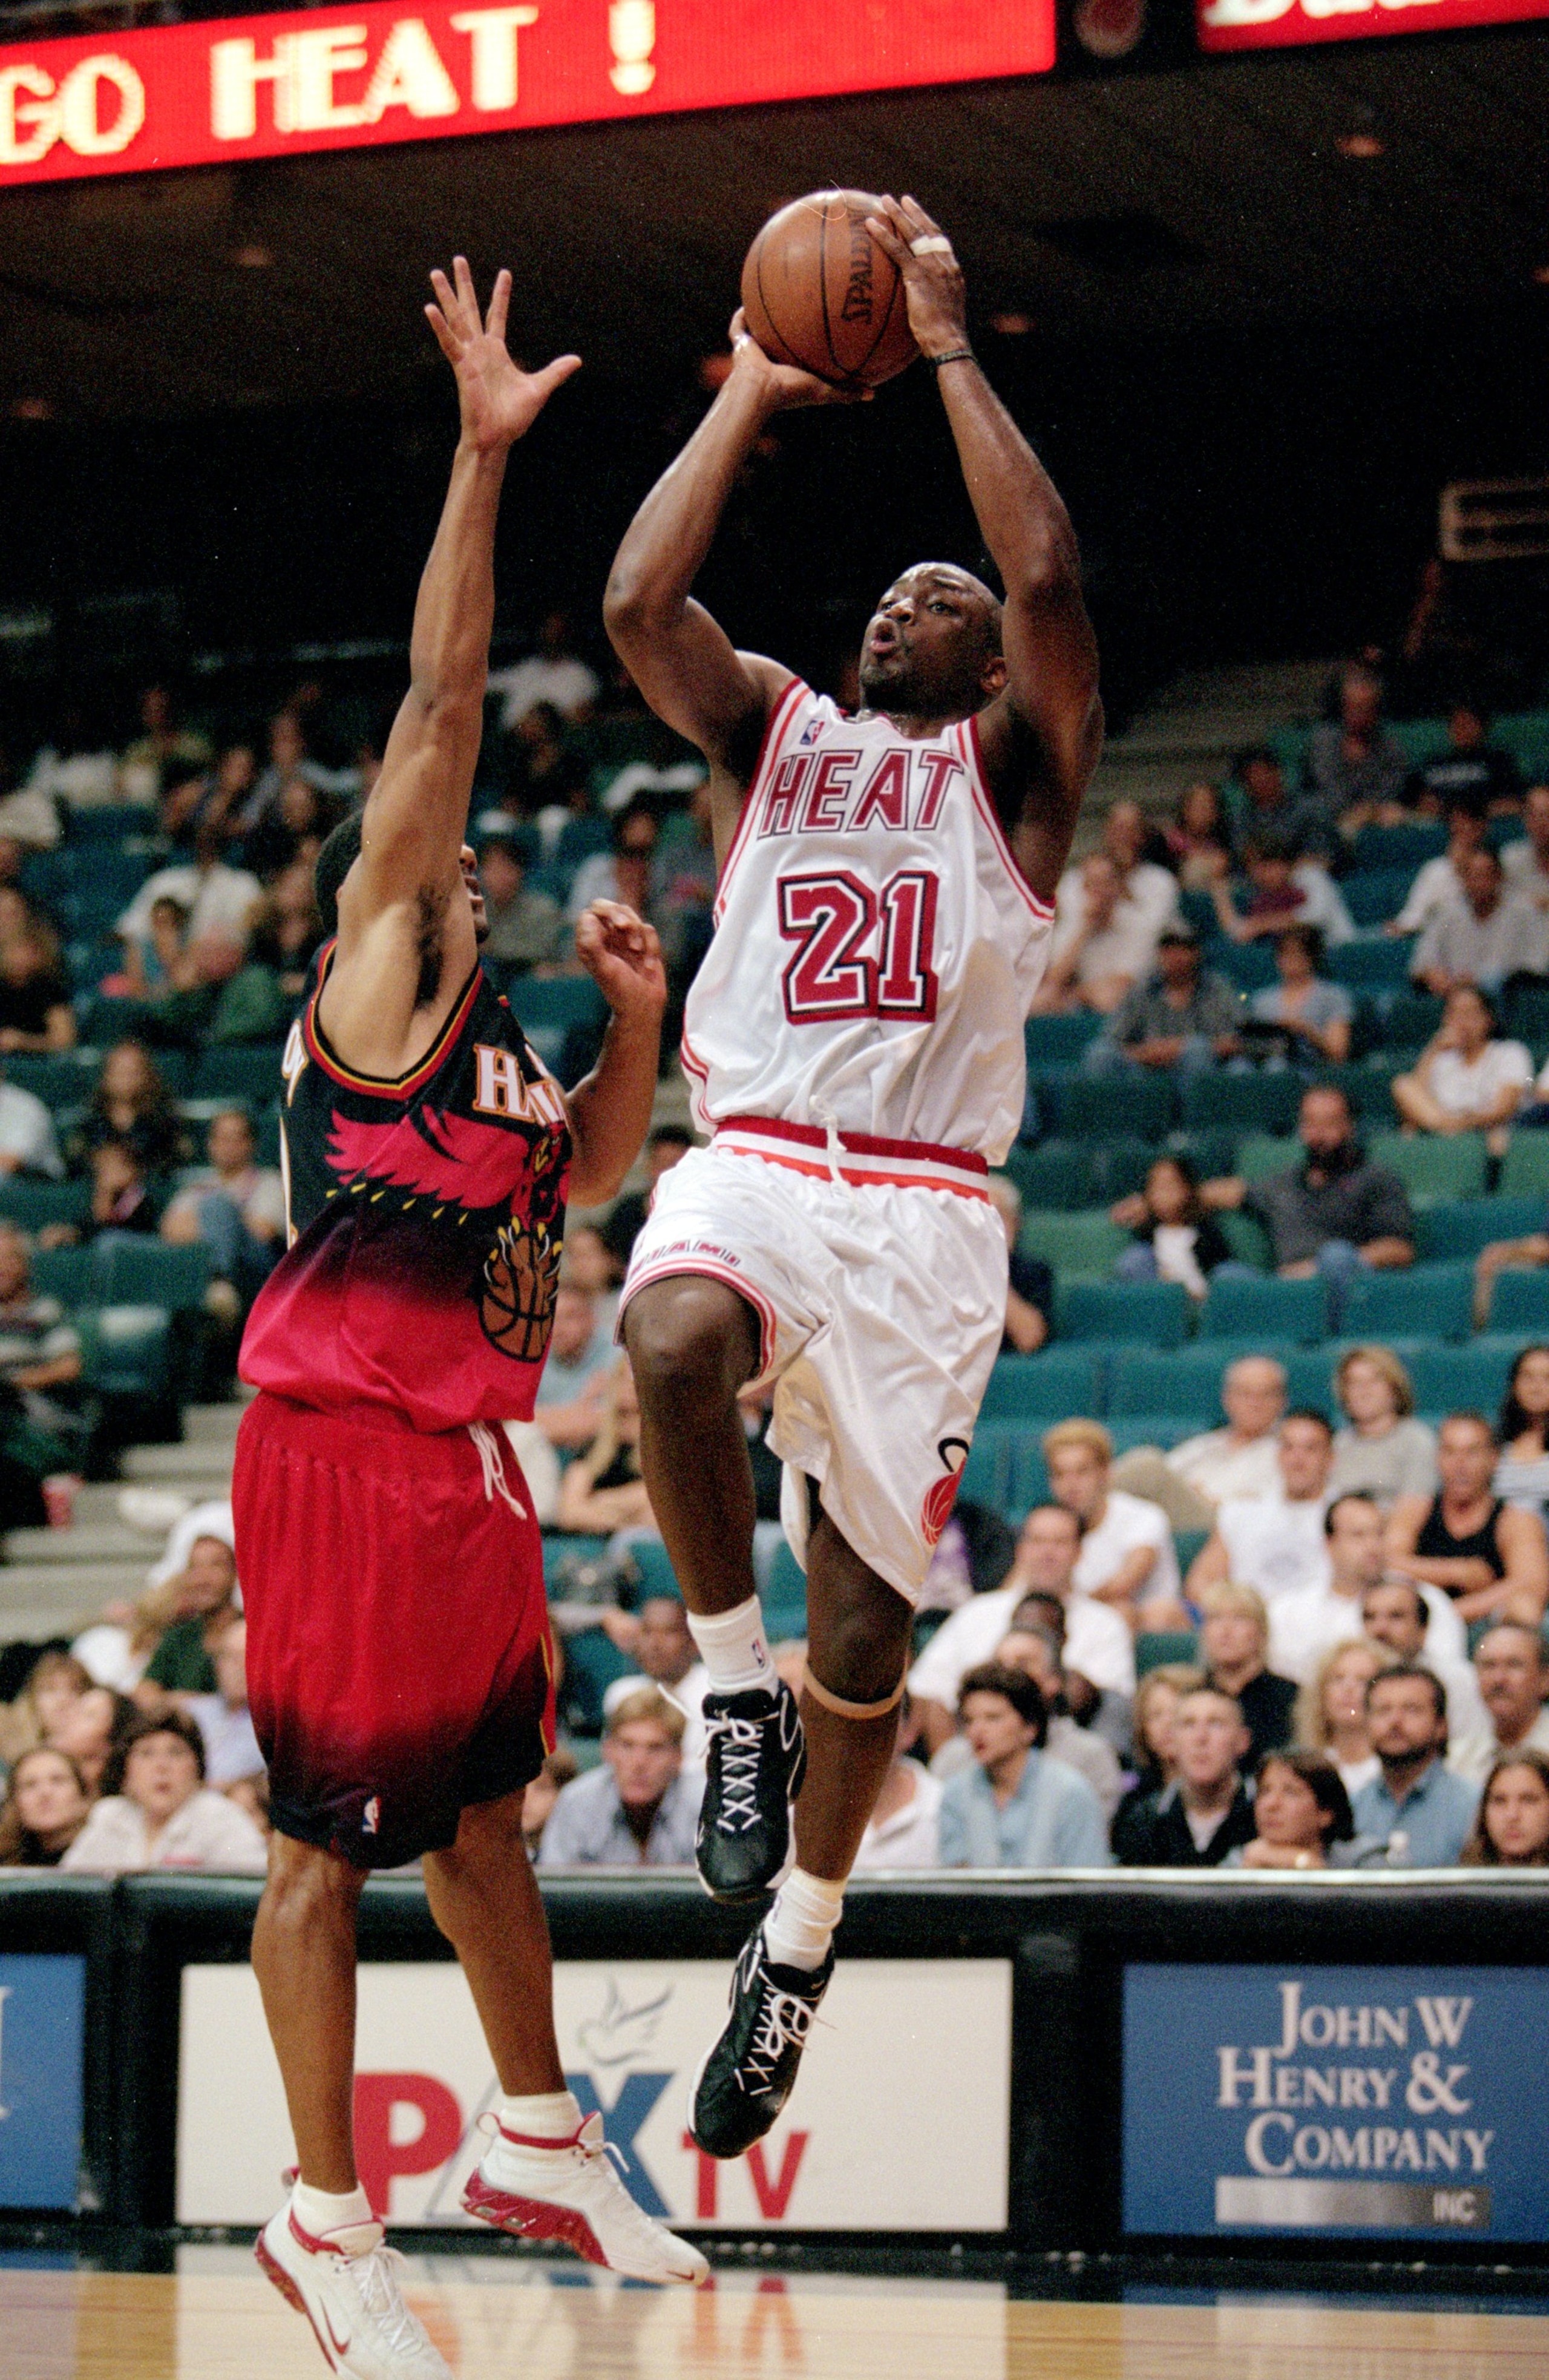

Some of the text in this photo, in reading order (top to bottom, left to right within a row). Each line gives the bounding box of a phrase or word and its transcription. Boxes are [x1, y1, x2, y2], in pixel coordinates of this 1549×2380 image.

[0, 53, 145, 165] GO
[209, 5, 539, 140] HEAT
[841, 206, 873, 324] SPALDIN
[757, 749, 964, 839] HEAT
[777, 870, 939, 1026] 21
[1271, 1982, 1474, 2059] JOHN W
[1217, 2047, 1471, 2115] HENRY &
[1245, 2111, 1494, 2176] COMPANY
[1433, 2191, 1476, 2223] INC
